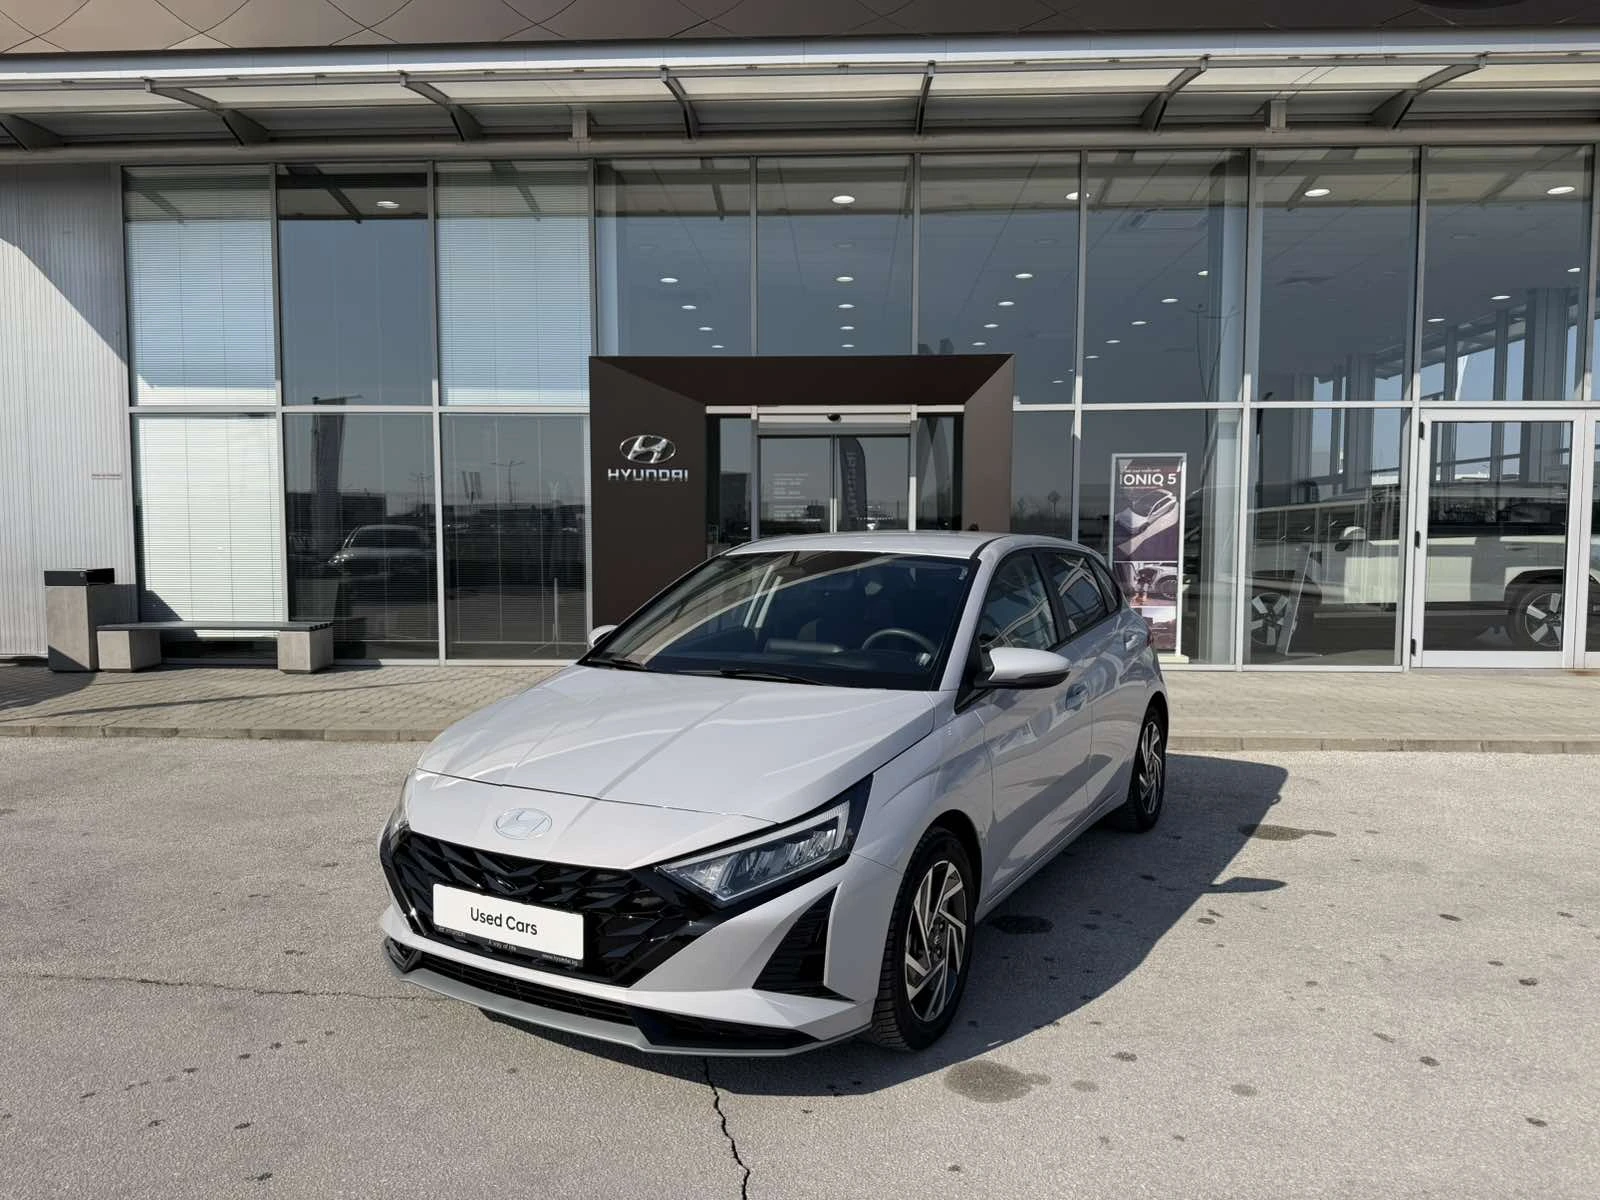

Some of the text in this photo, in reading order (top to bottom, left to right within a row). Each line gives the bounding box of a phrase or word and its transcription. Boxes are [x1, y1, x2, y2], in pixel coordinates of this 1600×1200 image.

[608, 469, 688, 481] HYUNDAI
[1167, 473, 1177, 485] 5
[470, 906, 538, 935] Used Cars
